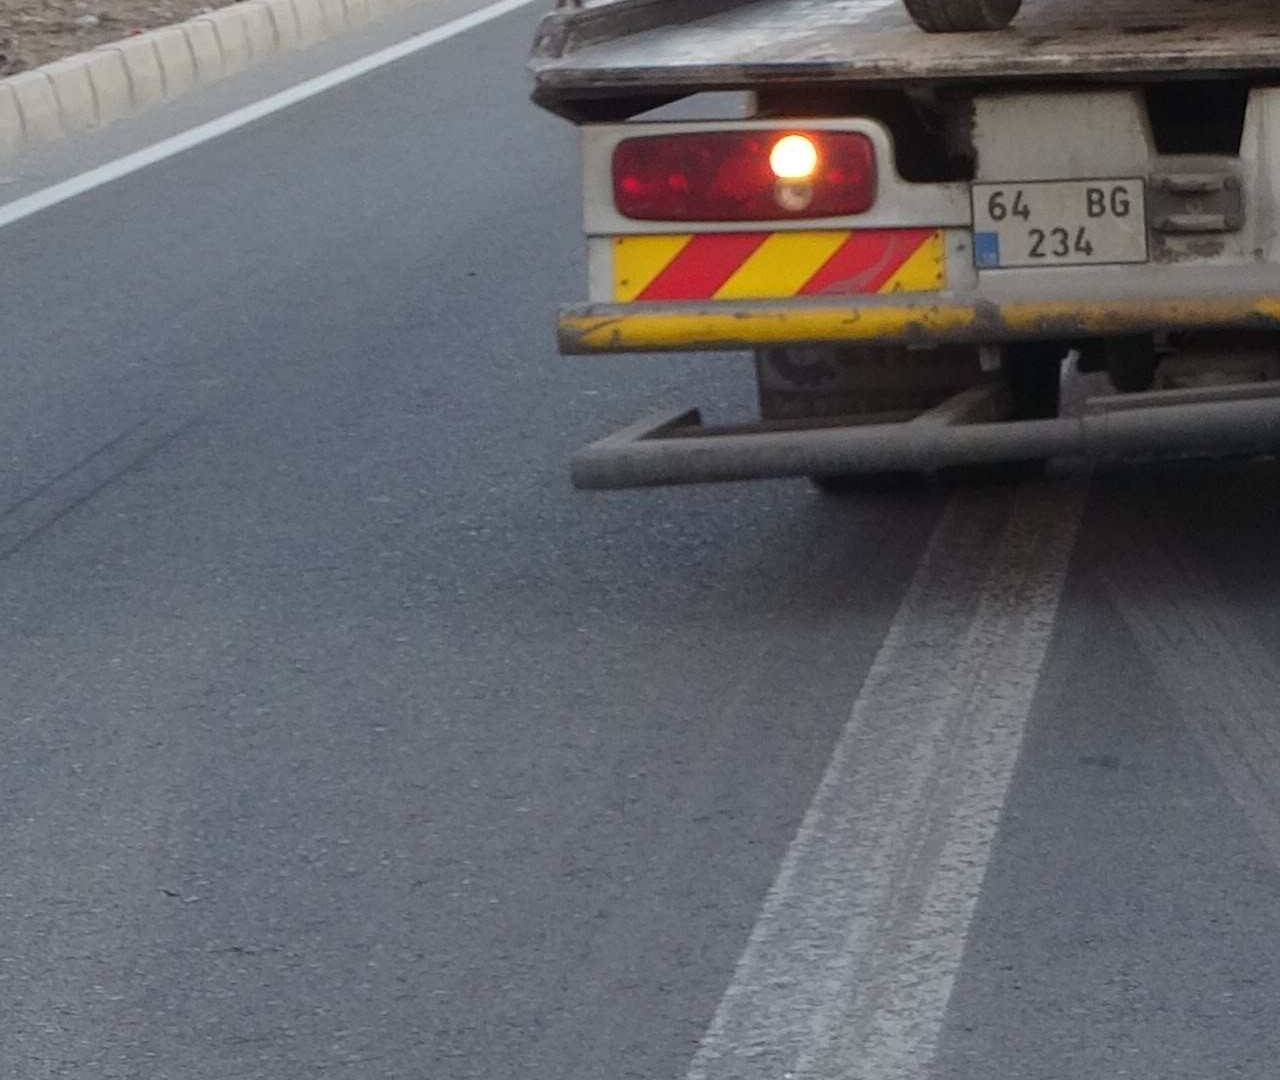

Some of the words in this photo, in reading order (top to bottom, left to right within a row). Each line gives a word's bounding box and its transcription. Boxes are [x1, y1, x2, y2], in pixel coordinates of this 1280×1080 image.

[988, 190, 1031, 222] 64
[1086, 185, 1130, 218] BG
[1028, 225, 1094, 258] 234
